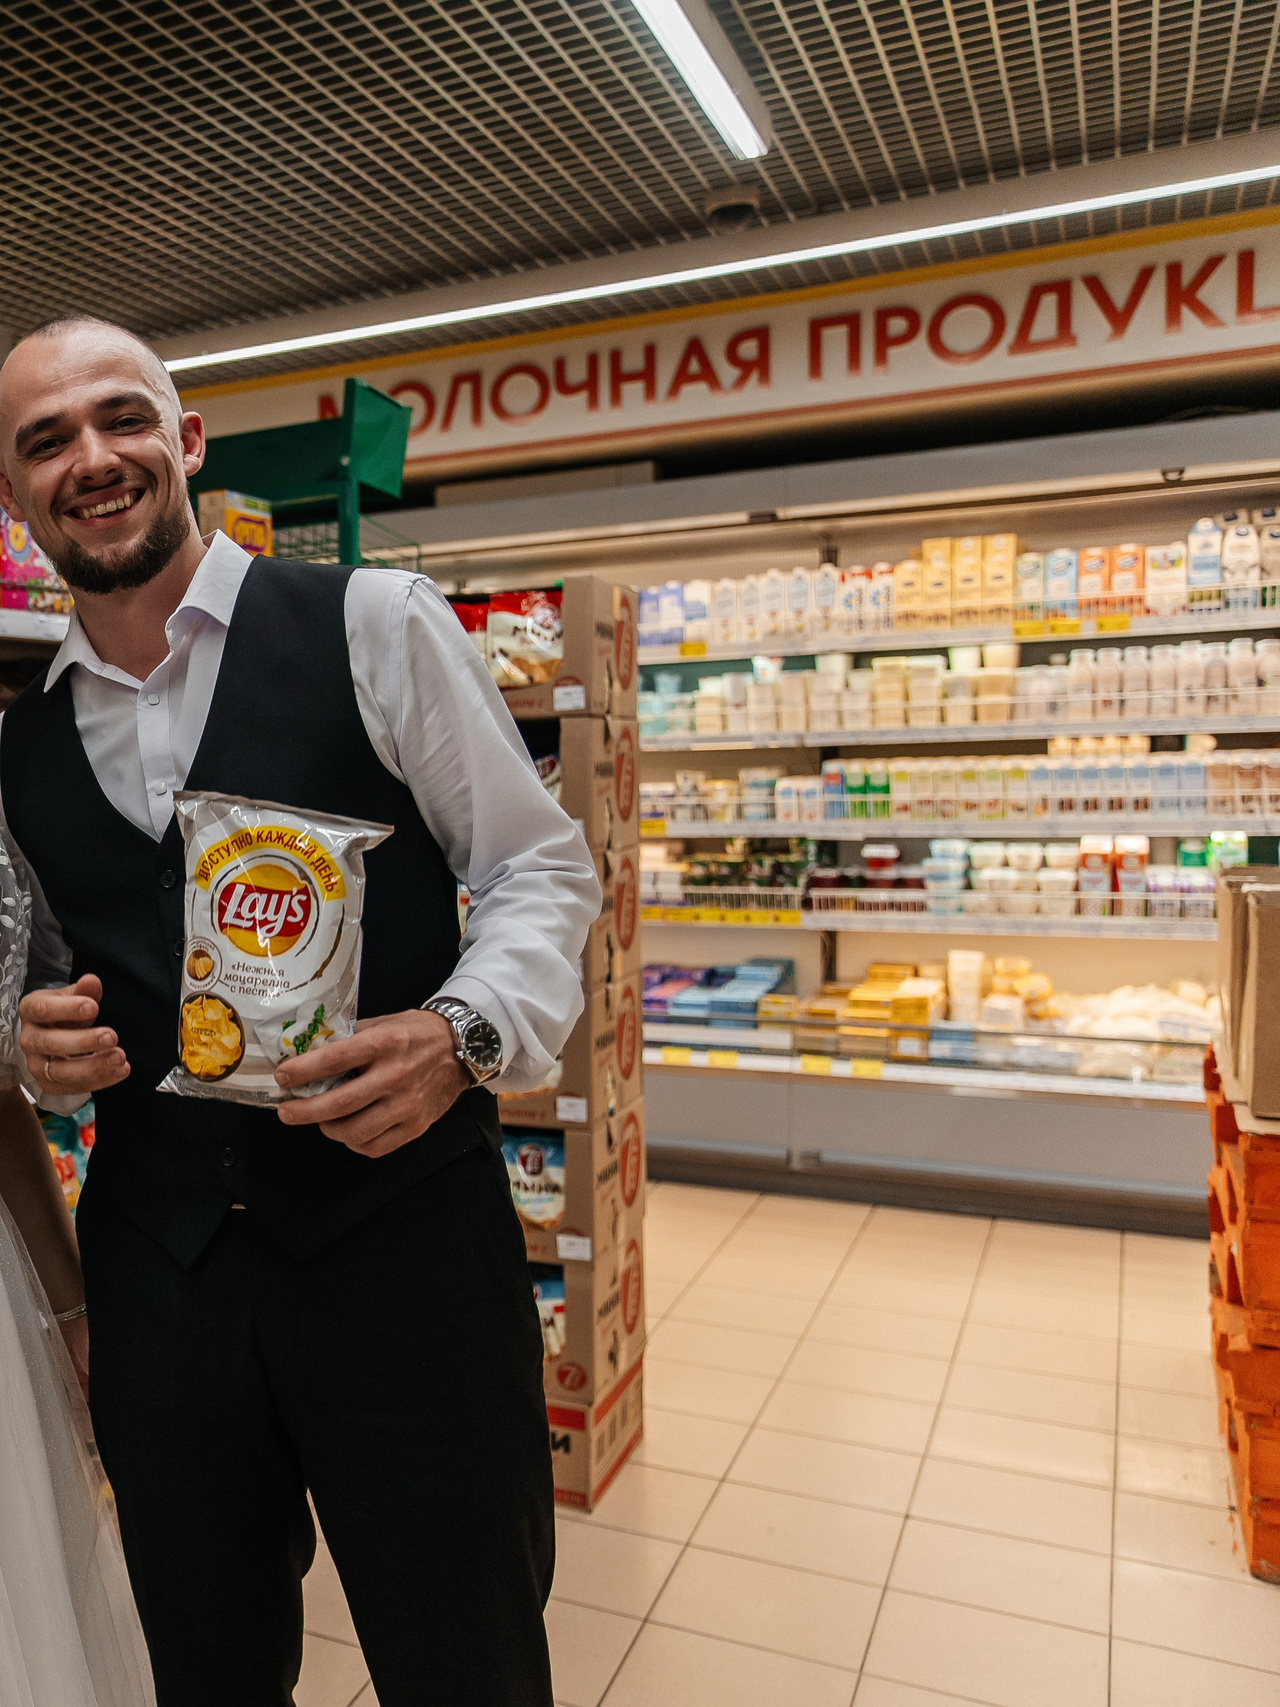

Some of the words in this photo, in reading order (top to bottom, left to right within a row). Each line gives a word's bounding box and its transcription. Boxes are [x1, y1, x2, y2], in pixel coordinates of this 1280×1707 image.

[197, 830, 254, 884] ДОСТУПНО
[221, 883, 308, 938] Lay's
[223, 973, 290, 988] моцарелла
[231, 961, 285, 977] «Нежная
